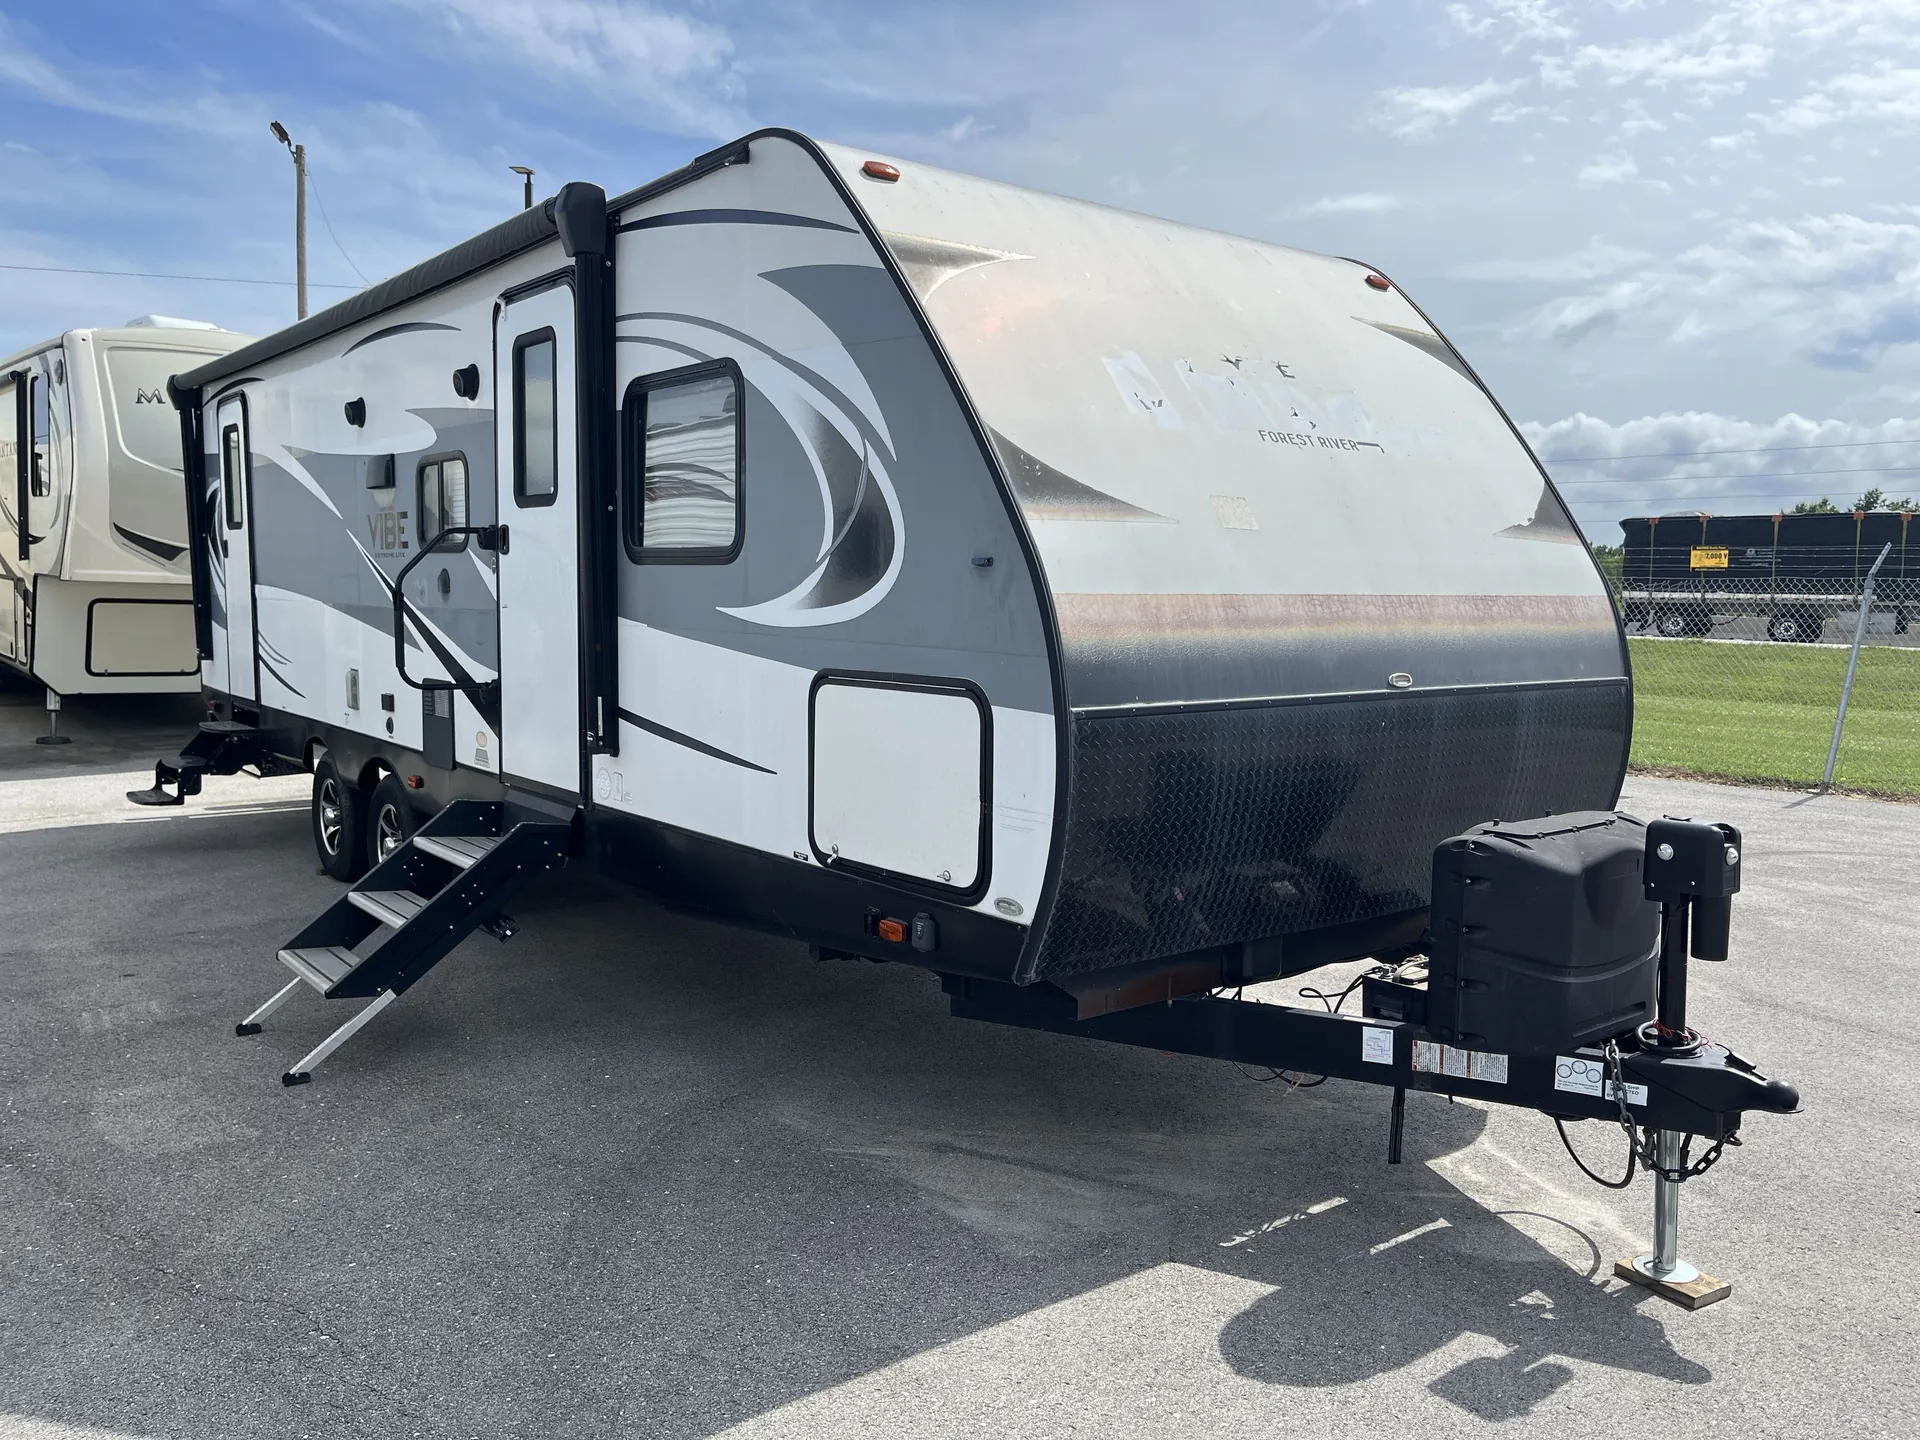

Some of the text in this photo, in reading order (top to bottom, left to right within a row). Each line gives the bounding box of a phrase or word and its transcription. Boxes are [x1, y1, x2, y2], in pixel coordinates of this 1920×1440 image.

[1257, 430, 1360, 451] FOREST RIVER
[367, 511, 409, 550] VIBE
